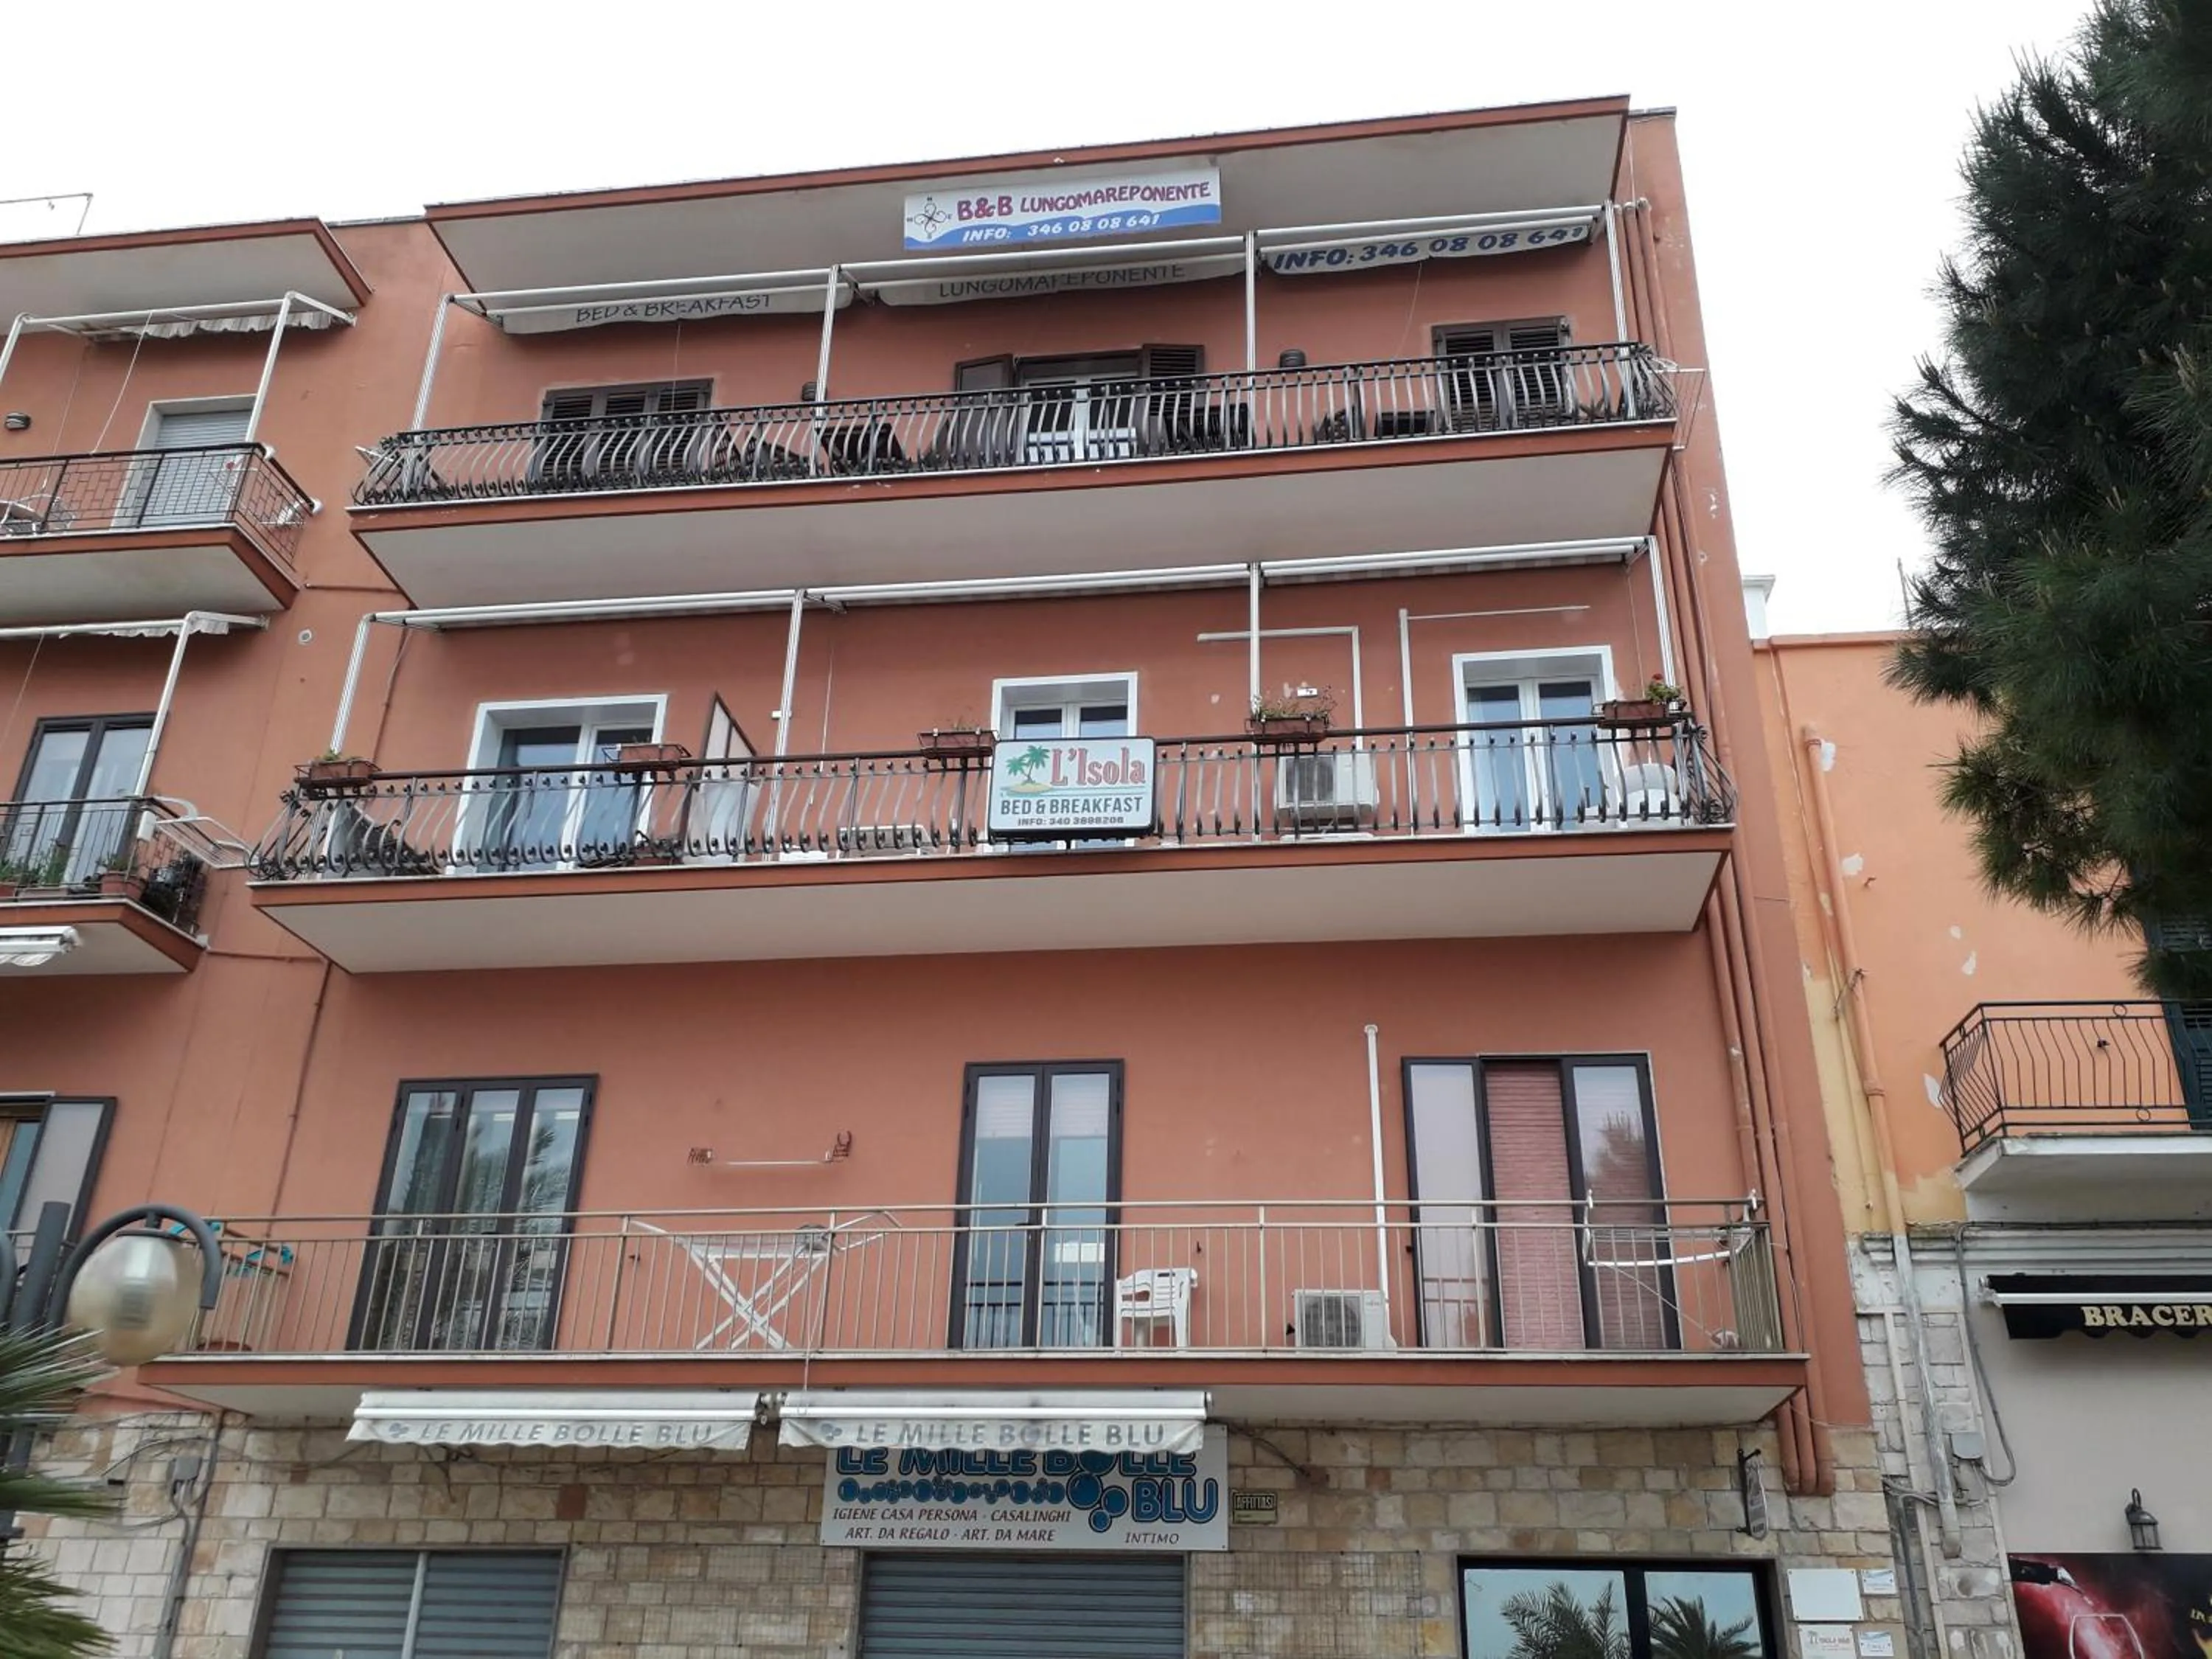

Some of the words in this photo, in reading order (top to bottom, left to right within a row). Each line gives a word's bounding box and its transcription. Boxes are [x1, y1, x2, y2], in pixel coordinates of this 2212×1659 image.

[958, 195, 1014, 220] B&B
[1020, 182, 1211, 212] LUNGOMAREPONENTE
[962, 228, 1012, 242] INFO:
[1027, 222, 1062, 237] 346
[1069, 218, 1092, 232] 08
[1098, 217, 1121, 230] 08
[1126, 214, 1161, 227] 641
[1273, 248, 1353, 270] INFO:
[1359, 241, 1419, 261] 346
[1428, 236, 1469, 252] 08
[1477, 232, 1517, 249] 08
[1527, 226, 1583, 244] 641
[577, 305, 620, 322] BED
[623, 305, 638, 316] &
[644, 294, 771, 316] BREAKFAST
[1050, 746, 1145, 786] L'Isola
[1001, 799, 1032, 815] BED
[1036, 799, 1045, 814] &
[1049, 796, 1143, 813] BREAKFAST
[1018, 817, 1047, 826] INFO:
[2081, 1305, 2212, 1326] BRACER
[419, 1422, 451, 1439] LE
[458, 1422, 544, 1441] MILLE
[552, 1424, 643, 1443] BOLLE
[655, 1425, 712, 1444] BLU
[856, 1423, 885, 1443] LE
[898, 1423, 986, 1444] MILLE
[999, 1423, 1092, 1445] BOLLE
[1105, 1424, 1164, 1446] BLU
[1133, 1478, 1218, 1523] BLU
[833, 1508, 877, 1520] IGIENE
[881, 1508, 914, 1520] CASA
[918, 1509, 977, 1521] PERSONA
[990, 1509, 1072, 1523] CASALINGHI
[845, 1527, 872, 1540] ART.
[878, 1527, 894, 1539] DA
[899, 1528, 950, 1540] REGALO
[961, 1528, 990, 1540] ART.
[995, 1528, 1012, 1541] DA
[1017, 1528, 1056, 1542] MARE
[1125, 1531, 1180, 1545] INTIMO
